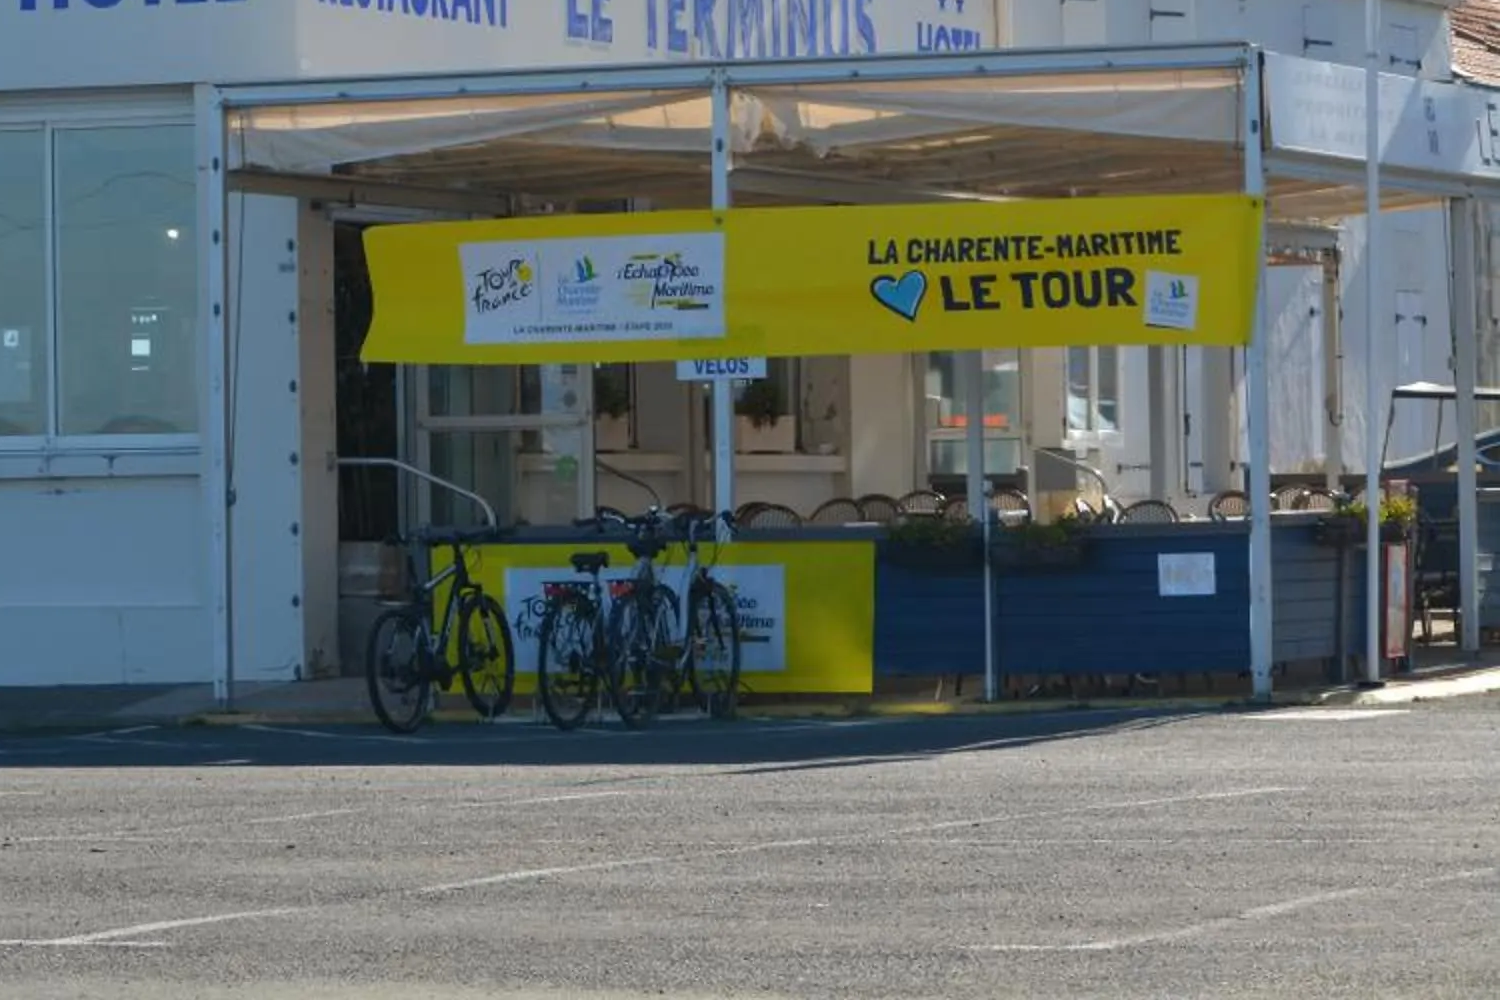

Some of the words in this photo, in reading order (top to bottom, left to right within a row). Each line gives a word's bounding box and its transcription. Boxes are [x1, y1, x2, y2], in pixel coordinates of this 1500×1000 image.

[867, 239, 899, 265] LA
[906, 229, 1183, 264] CHARENTE-MARITIME
[940, 274, 1001, 312] LE
[1011, 267, 1138, 310] TOUR
